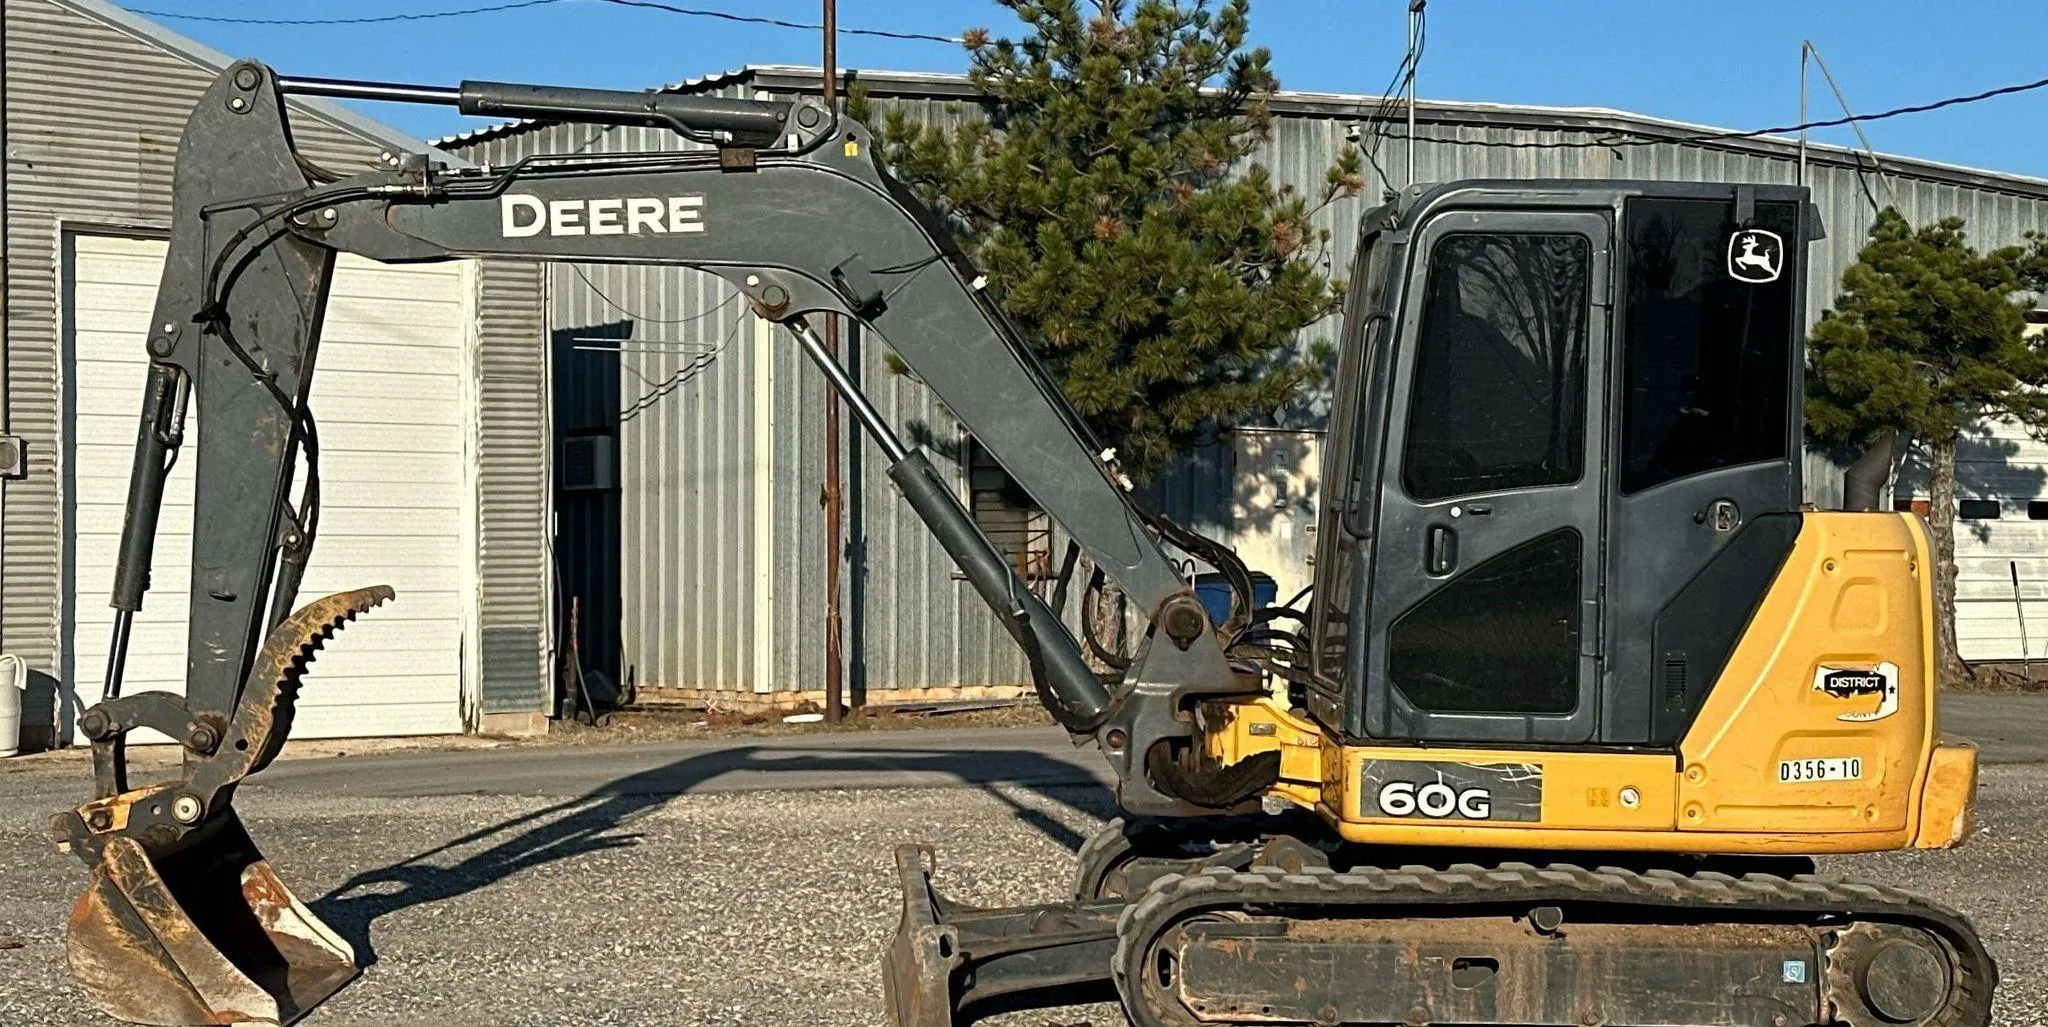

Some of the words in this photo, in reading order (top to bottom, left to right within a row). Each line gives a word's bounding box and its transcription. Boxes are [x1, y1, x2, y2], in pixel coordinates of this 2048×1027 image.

[501, 194, 704, 238] DEERE
[1829, 676, 1880, 688] DISTRICT
[1781, 759, 1860, 781] D356-10
[1379, 780, 1491, 819] 60G
